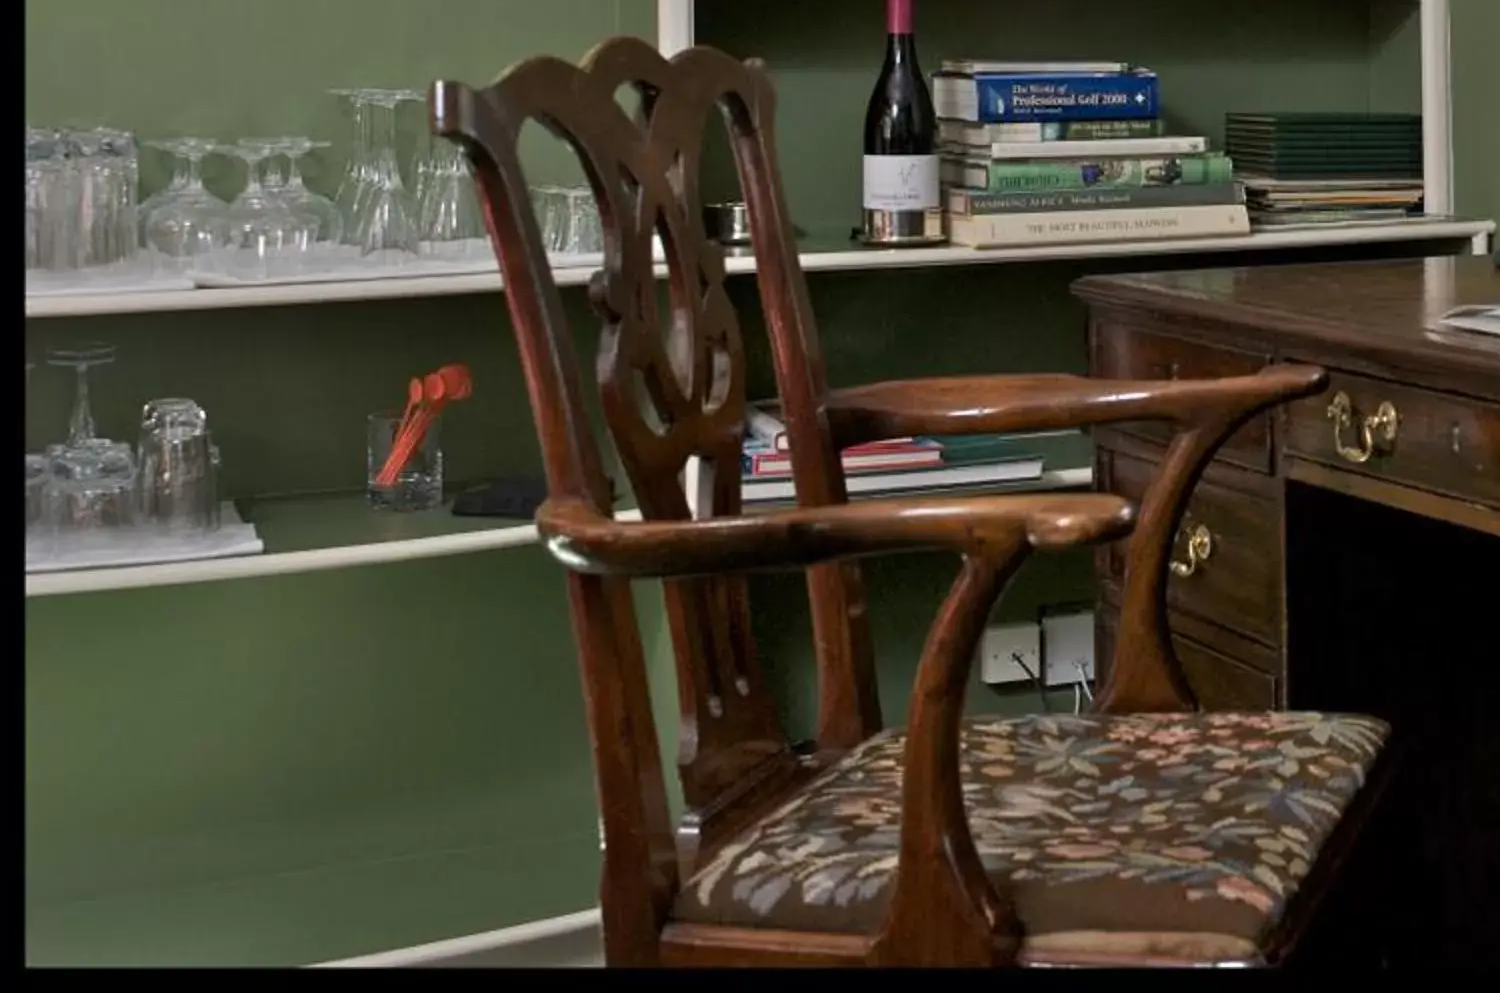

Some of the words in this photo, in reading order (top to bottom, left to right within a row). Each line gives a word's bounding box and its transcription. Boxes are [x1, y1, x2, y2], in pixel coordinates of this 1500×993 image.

[1012, 92, 1076, 106] Professional
[1077, 93, 1101, 106] Golf
[1026, 223, 1044, 234] THE
[1048, 222, 1077, 233] MOST
[1079, 220, 1130, 233] BEAUTIFUL
